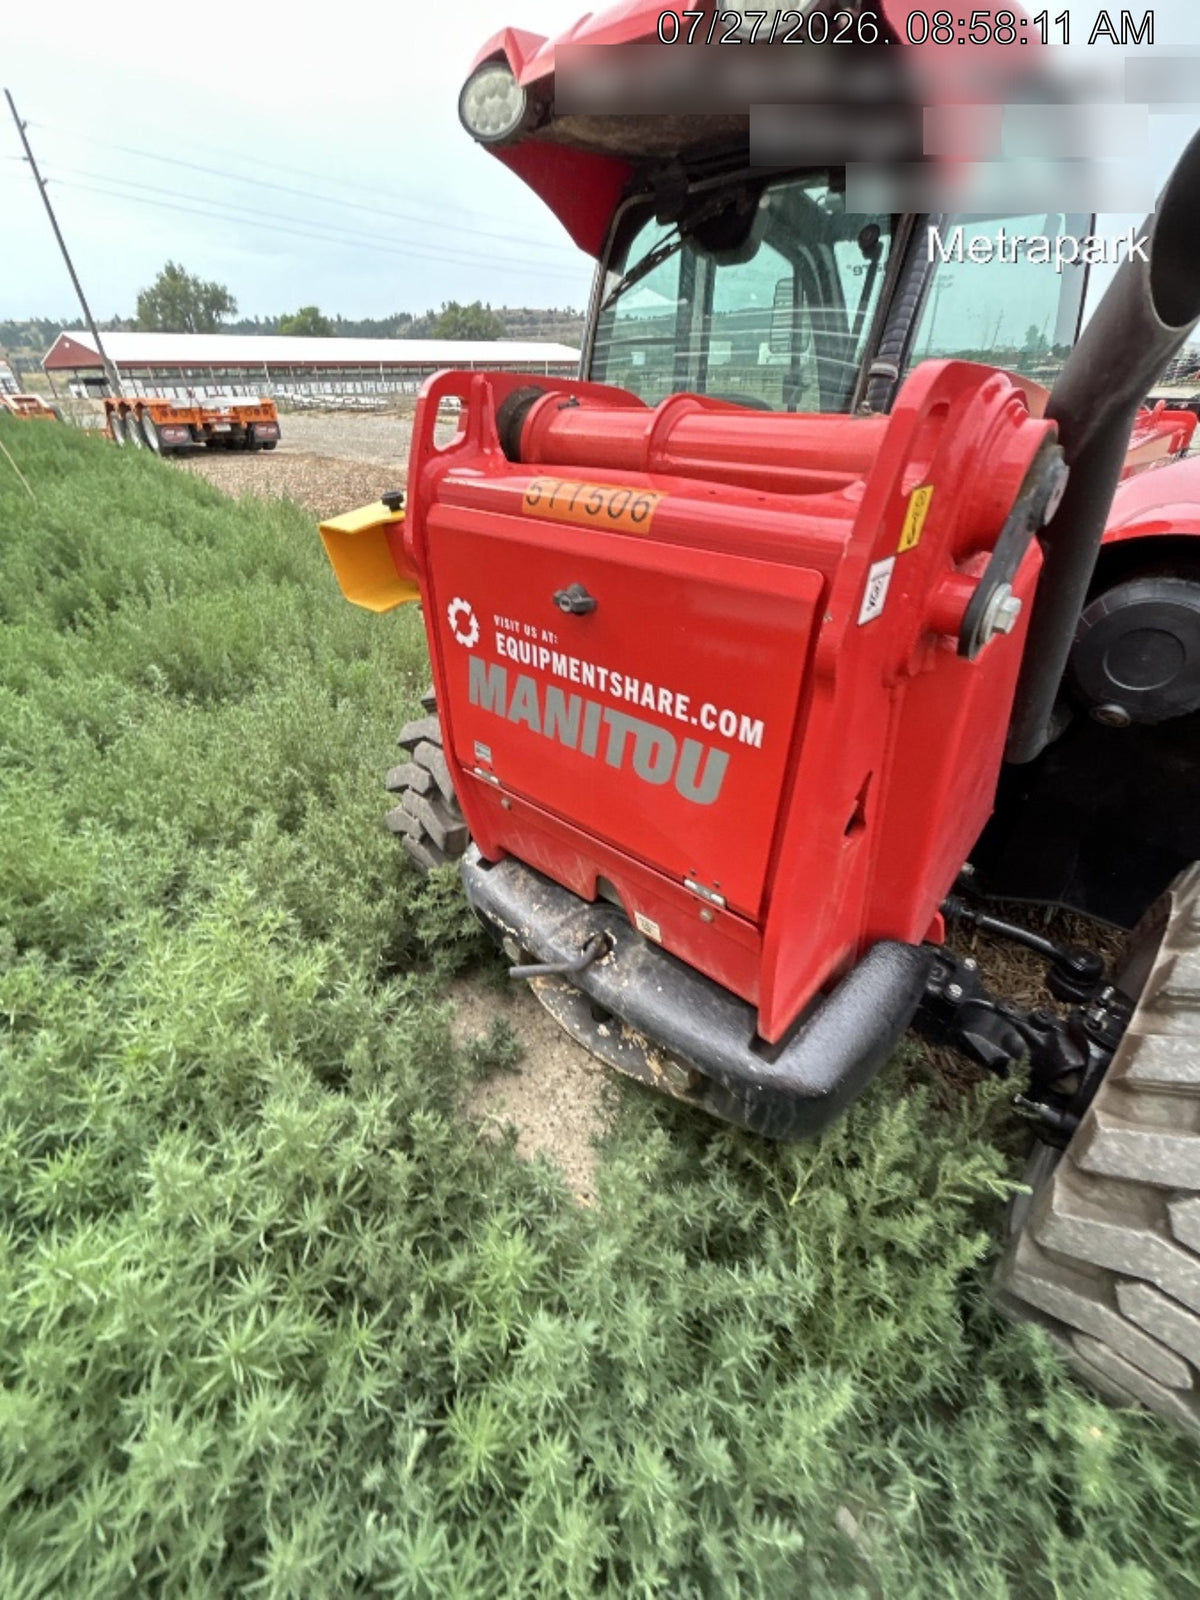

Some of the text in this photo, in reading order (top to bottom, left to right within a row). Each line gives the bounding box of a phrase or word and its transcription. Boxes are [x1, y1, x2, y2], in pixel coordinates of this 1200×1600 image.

[493, 614, 558, 645] VISIT US AT:
[468, 654, 731, 806] MANITOU
[495, 631, 765, 749] EQUIPMENTSHARE.COM
